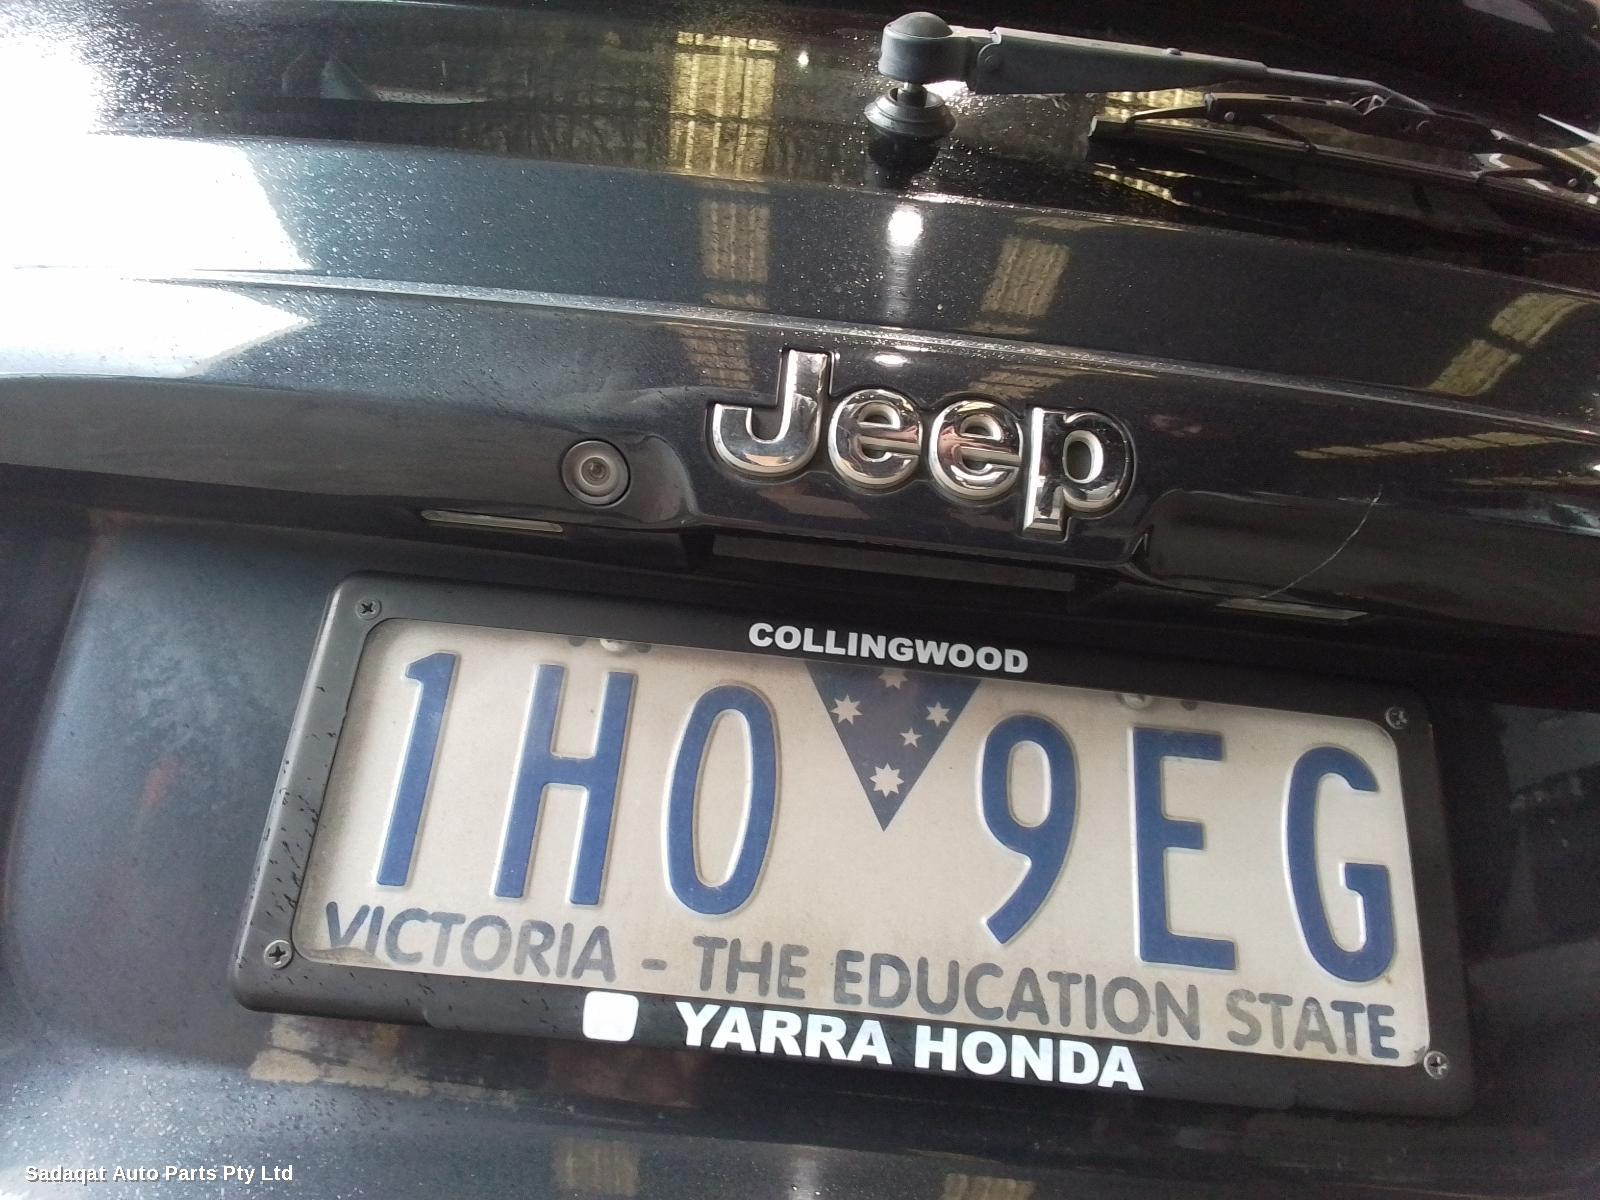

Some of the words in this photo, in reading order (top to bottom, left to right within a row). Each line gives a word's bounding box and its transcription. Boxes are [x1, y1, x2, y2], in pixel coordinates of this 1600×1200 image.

[709, 349, 1137, 538] Jeep
[748, 622, 1029, 674] COLLINGWOOD
[978, 713, 1398, 984] 9EG
[325, 901, 616, 983] VICTORIA
[693, 935, 809, 1003] THE
[833, 949, 1200, 1040] EDUCATION
[1226, 988, 1400, 1060] STATE
[675, 1001, 893, 1067] YARRA
[914, 1023, 1144, 1093] HONDA
